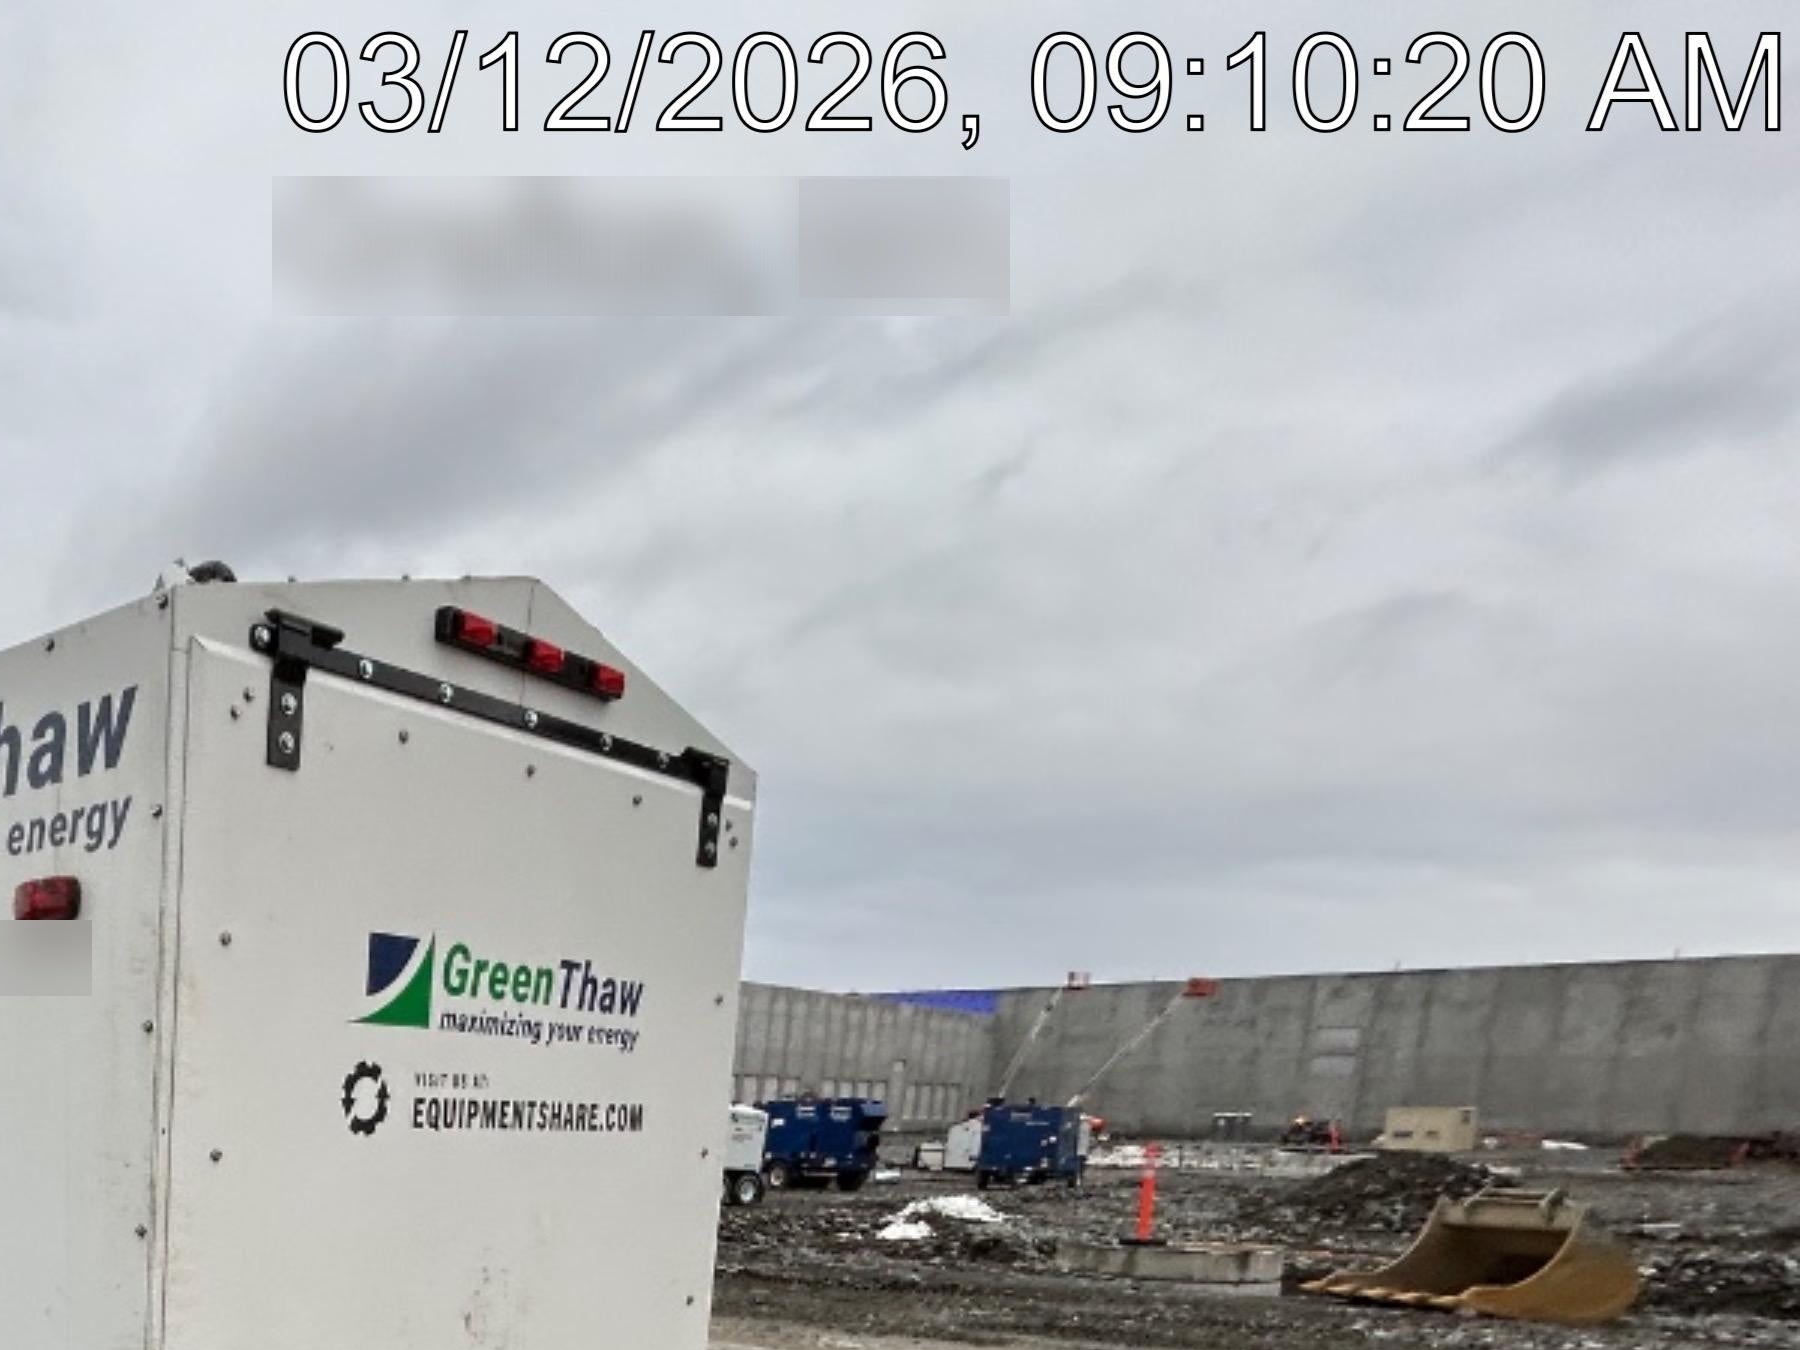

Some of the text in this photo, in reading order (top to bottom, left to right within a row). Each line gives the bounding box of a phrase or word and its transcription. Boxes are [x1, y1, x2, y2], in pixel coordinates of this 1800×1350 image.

[7, 795, 132, 856] energy
[438, 1008, 640, 1053] maximizing your energy
[412, 1097, 644, 1132] EQUIPMENTSHARE.COM
